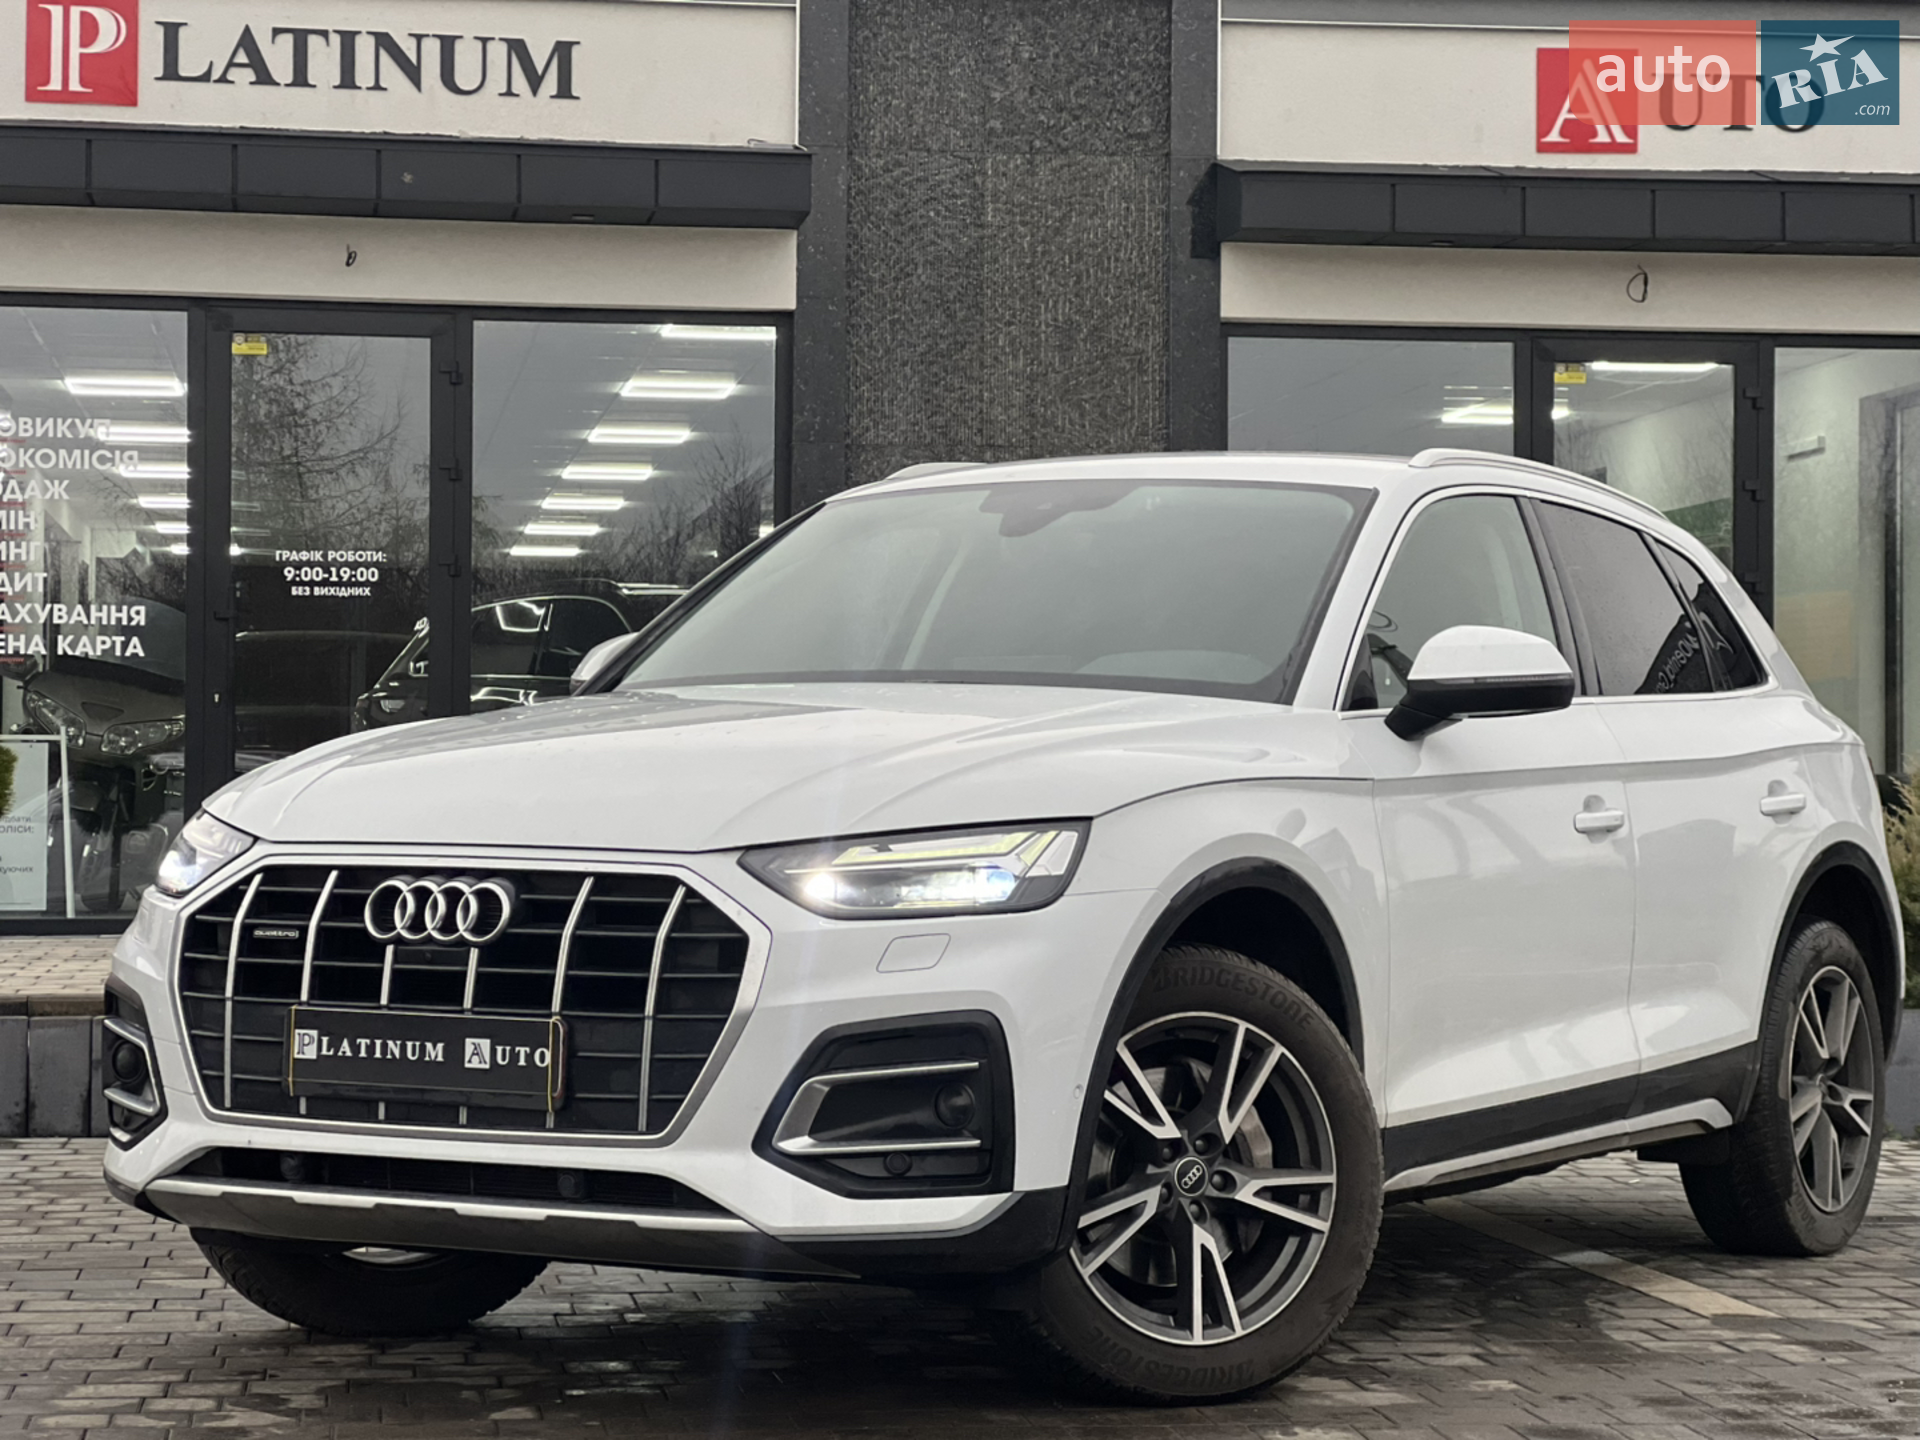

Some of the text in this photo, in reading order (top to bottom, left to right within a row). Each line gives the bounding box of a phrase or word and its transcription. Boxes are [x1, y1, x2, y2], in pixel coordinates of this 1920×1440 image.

[36, 3, 582, 101] PLATINUM
[0, 479, 70, 502] ДАЖ
[275, 550, 387, 562] ГРАФІК РОБОТИ:
[283, 566, 379, 582] 9:00-19:00
[291, 586, 371, 598] БЕЗ ВИХІДНИХ
[57, 634, 145, 657] КАРТА
[1153, 965, 1314, 1031] BRIDGESTONE
[294, 1031, 551, 1069] PLATINUM AUTO
